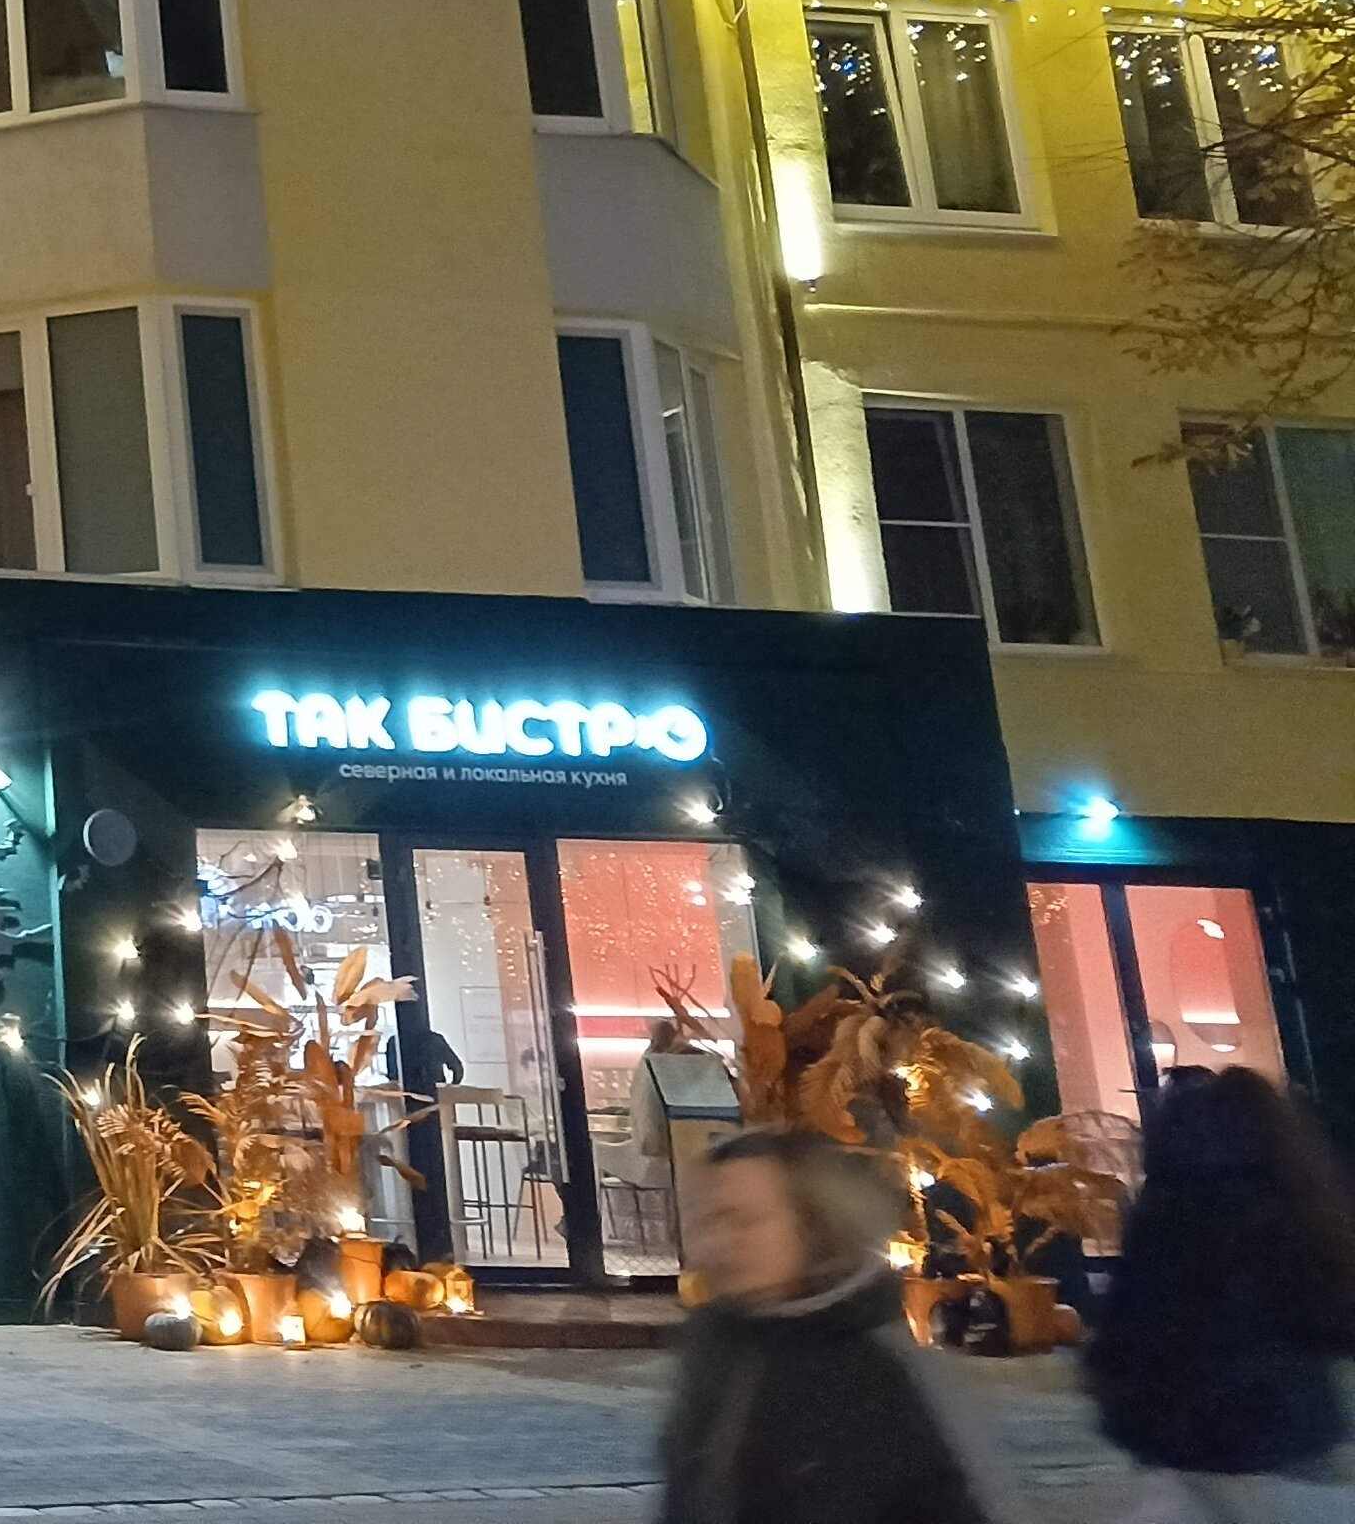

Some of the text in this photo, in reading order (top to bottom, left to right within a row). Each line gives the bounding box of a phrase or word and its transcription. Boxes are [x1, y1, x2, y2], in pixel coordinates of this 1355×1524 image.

[252, 689, 396, 751] ТАК
[339, 762, 628, 788] северная и локальная кухня
